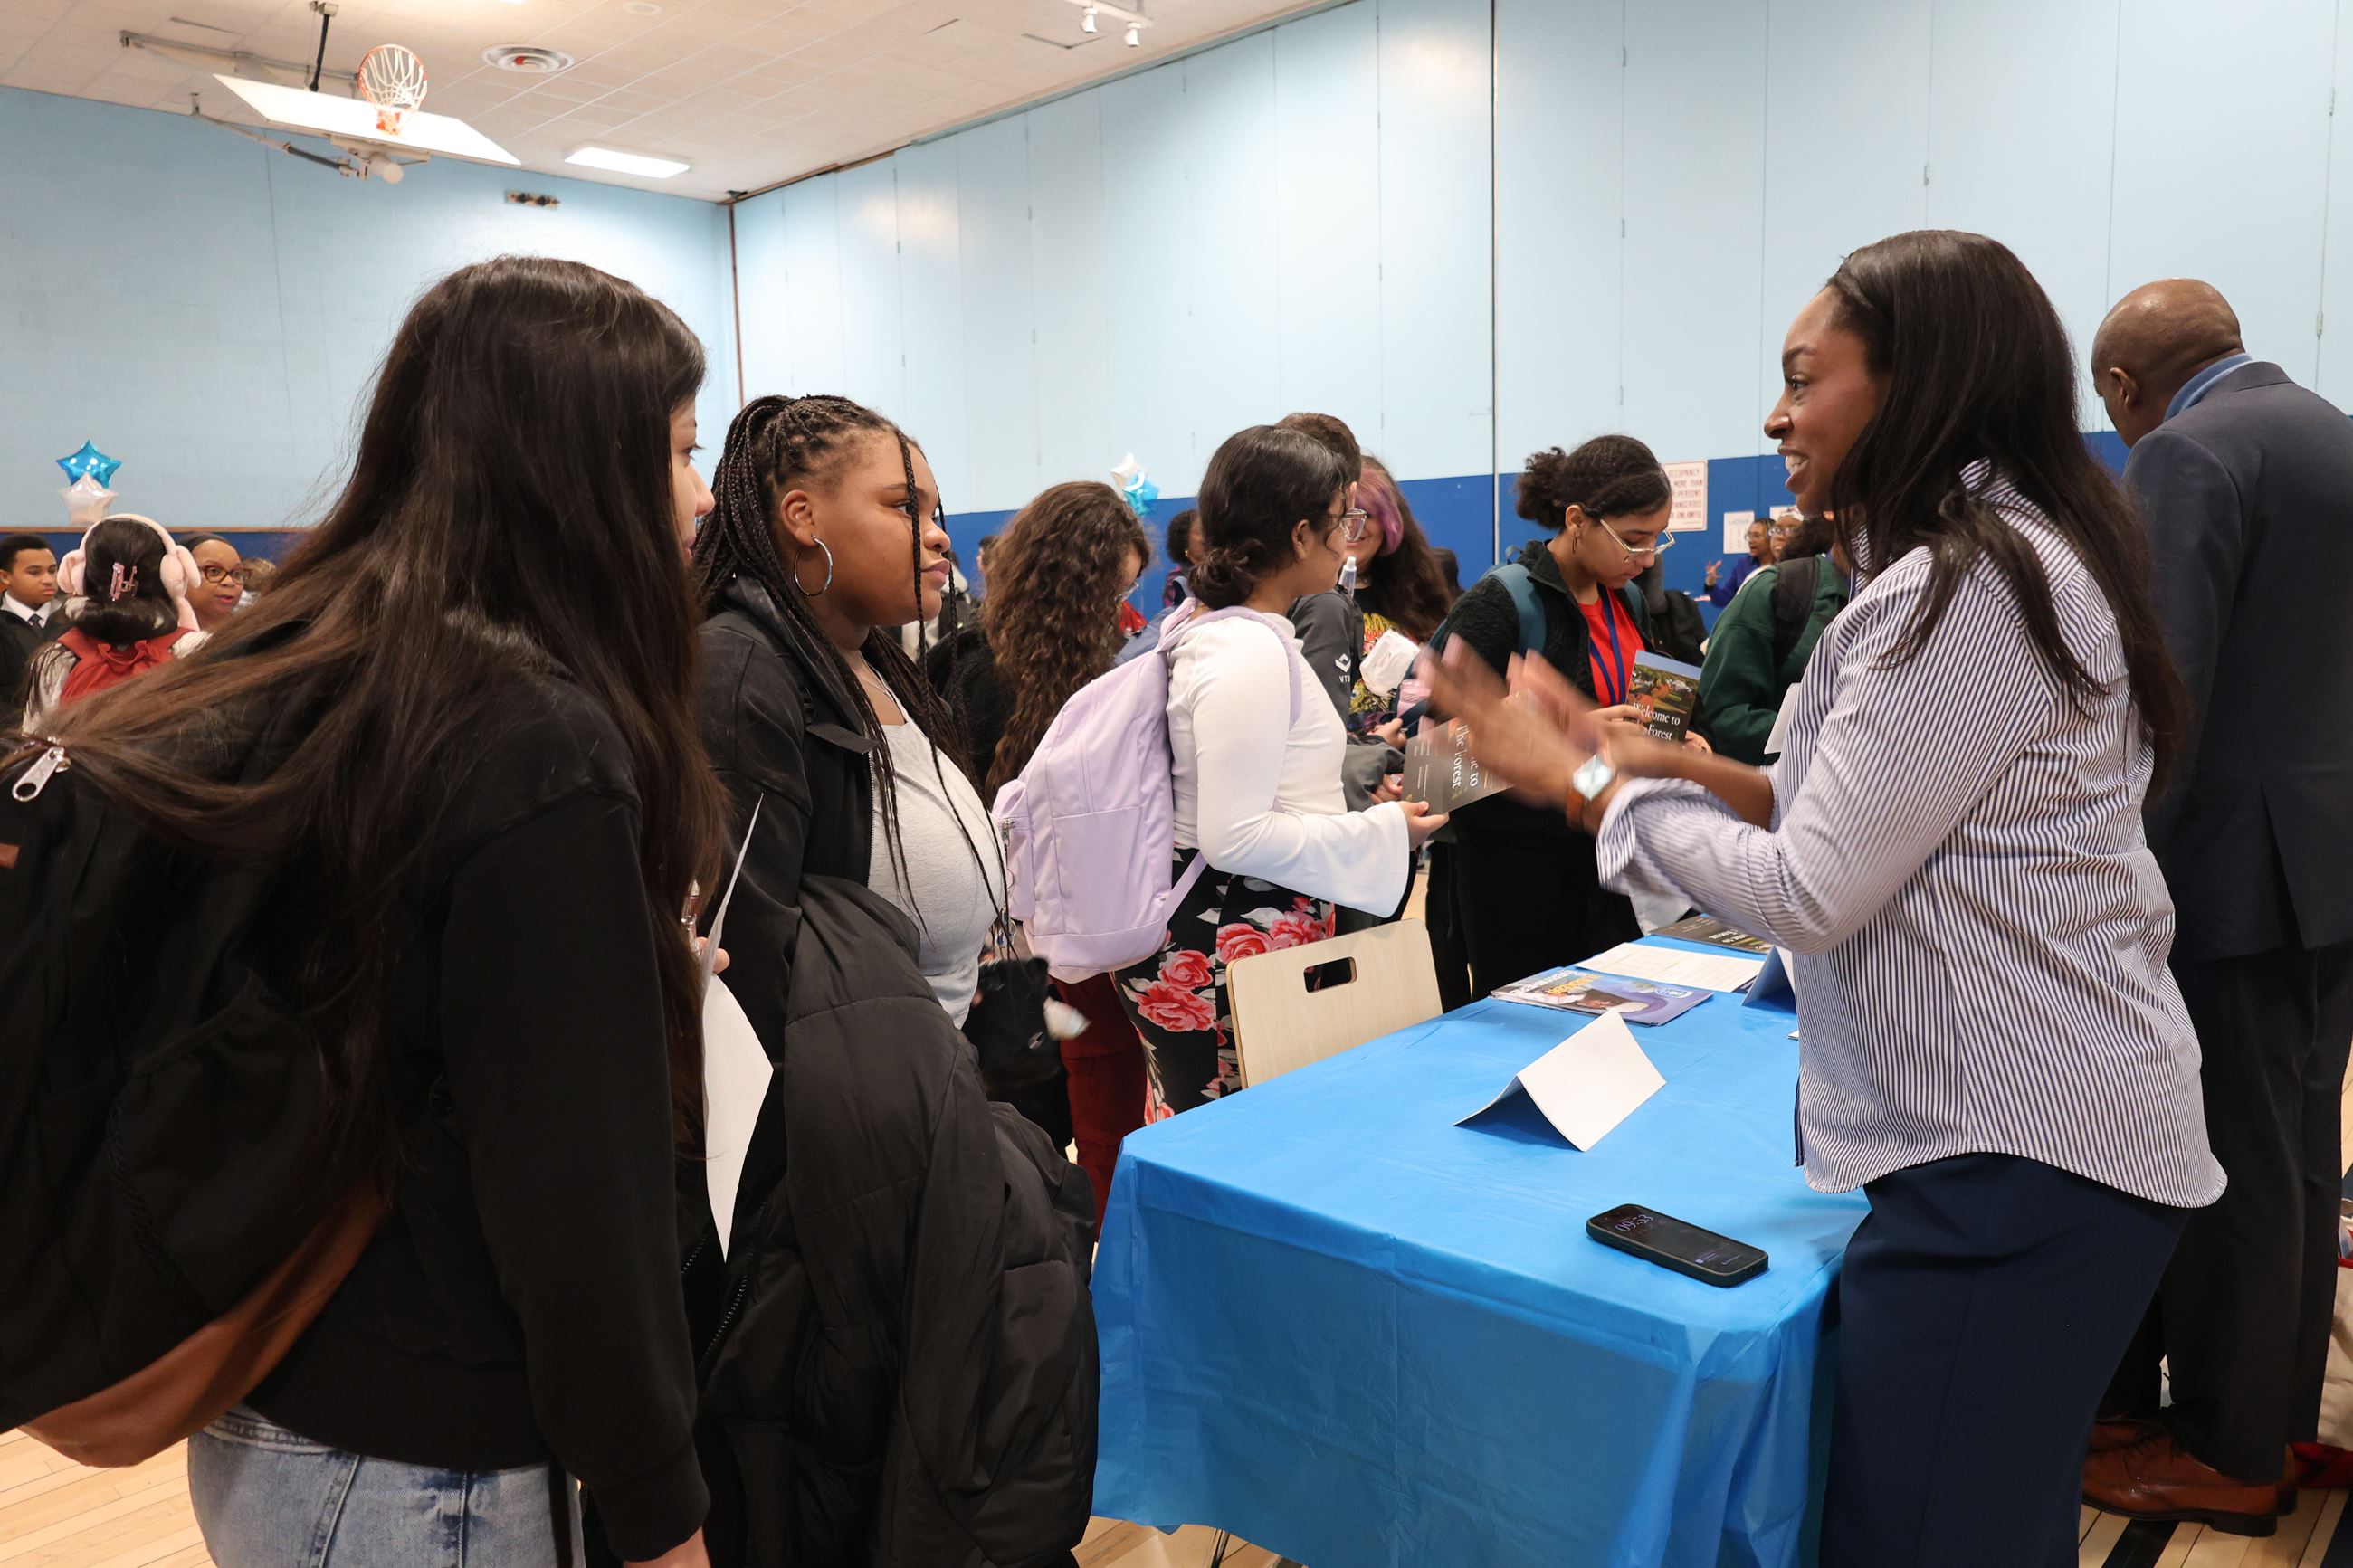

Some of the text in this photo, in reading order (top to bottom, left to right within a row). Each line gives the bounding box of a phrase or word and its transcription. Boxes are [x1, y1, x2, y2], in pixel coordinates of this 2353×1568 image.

[1671, 715, 1681, 726] to
[1647, 724, 1673, 741] Forest
[1452, 749, 1468, 789] Forest
[1468, 772, 1480, 787] to
